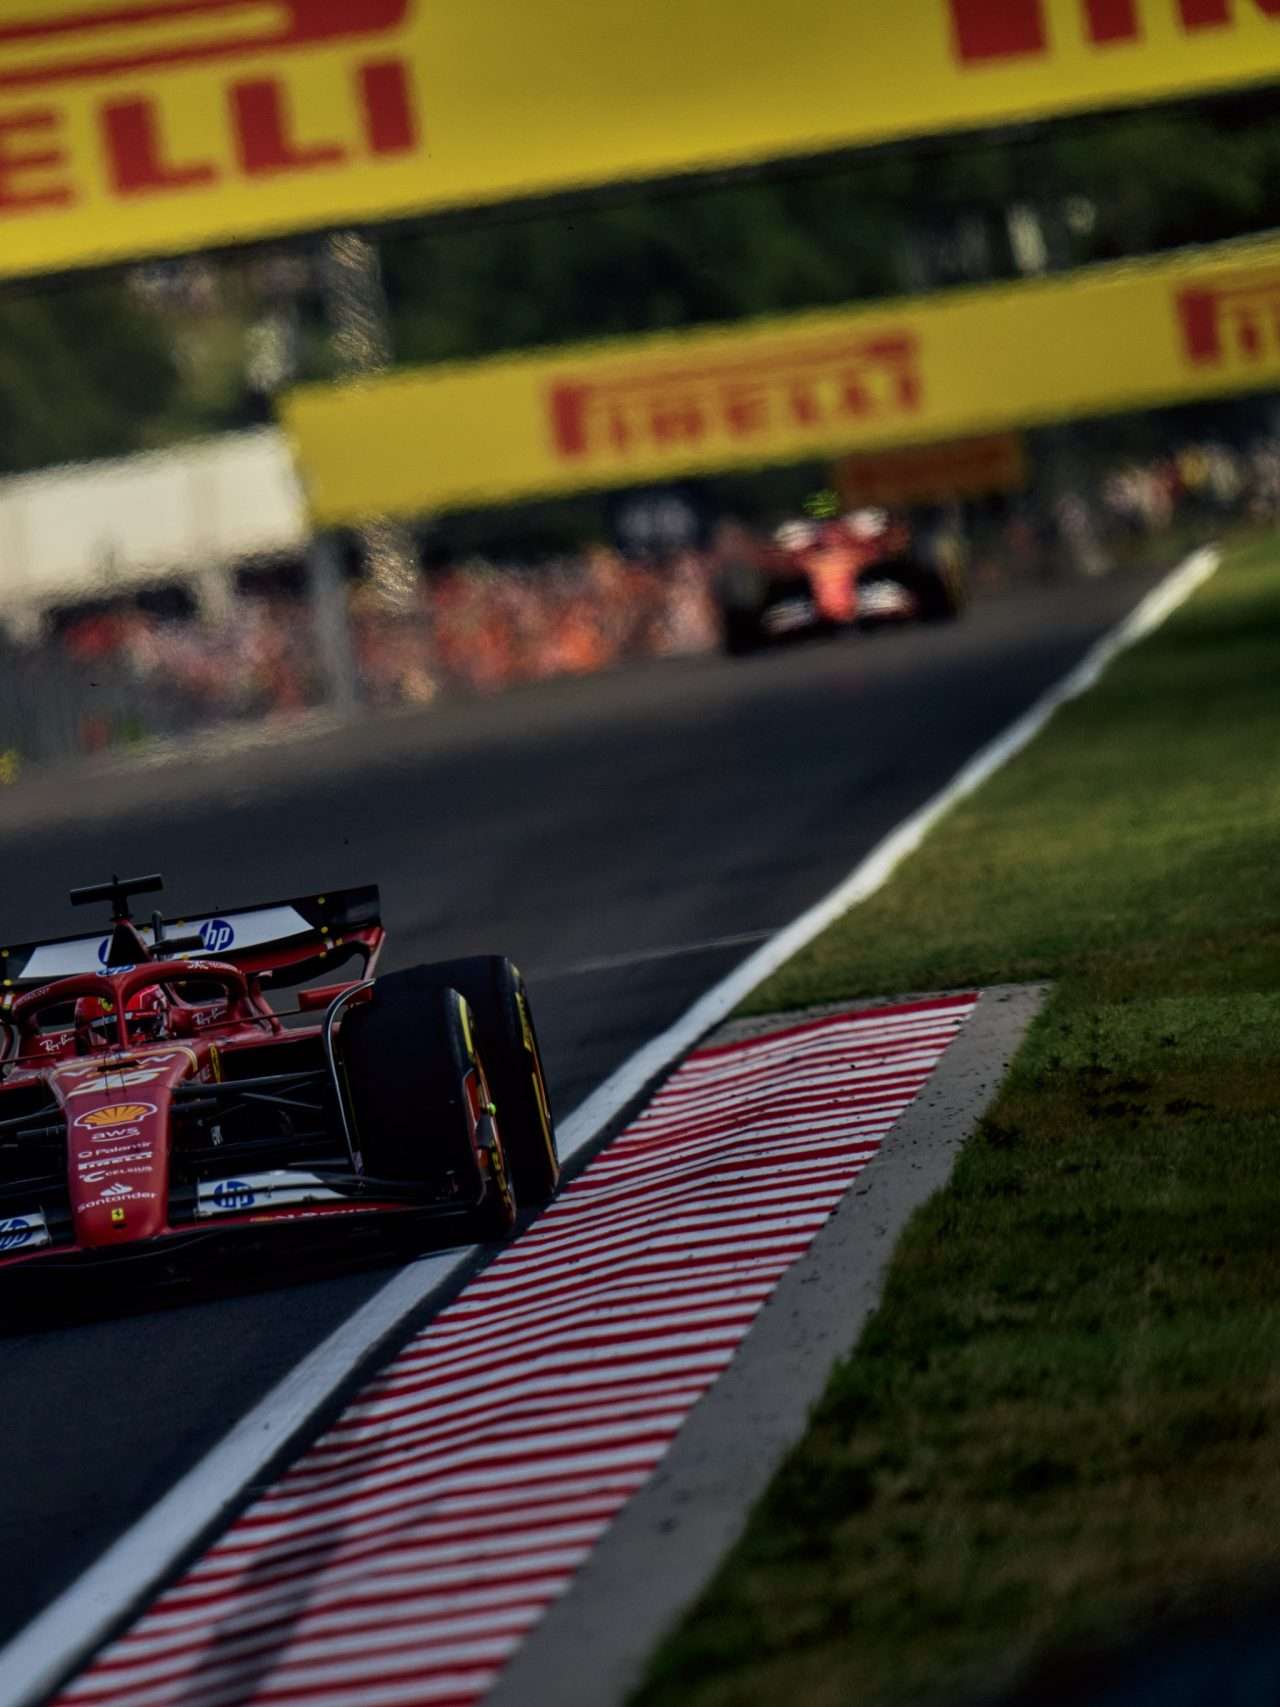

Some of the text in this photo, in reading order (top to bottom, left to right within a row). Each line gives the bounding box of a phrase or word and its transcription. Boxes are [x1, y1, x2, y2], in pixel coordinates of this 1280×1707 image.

[548, 332, 922, 460] PIRELLI
[201, 920, 234, 950] hp
[91, 1126, 141, 1140] aws
